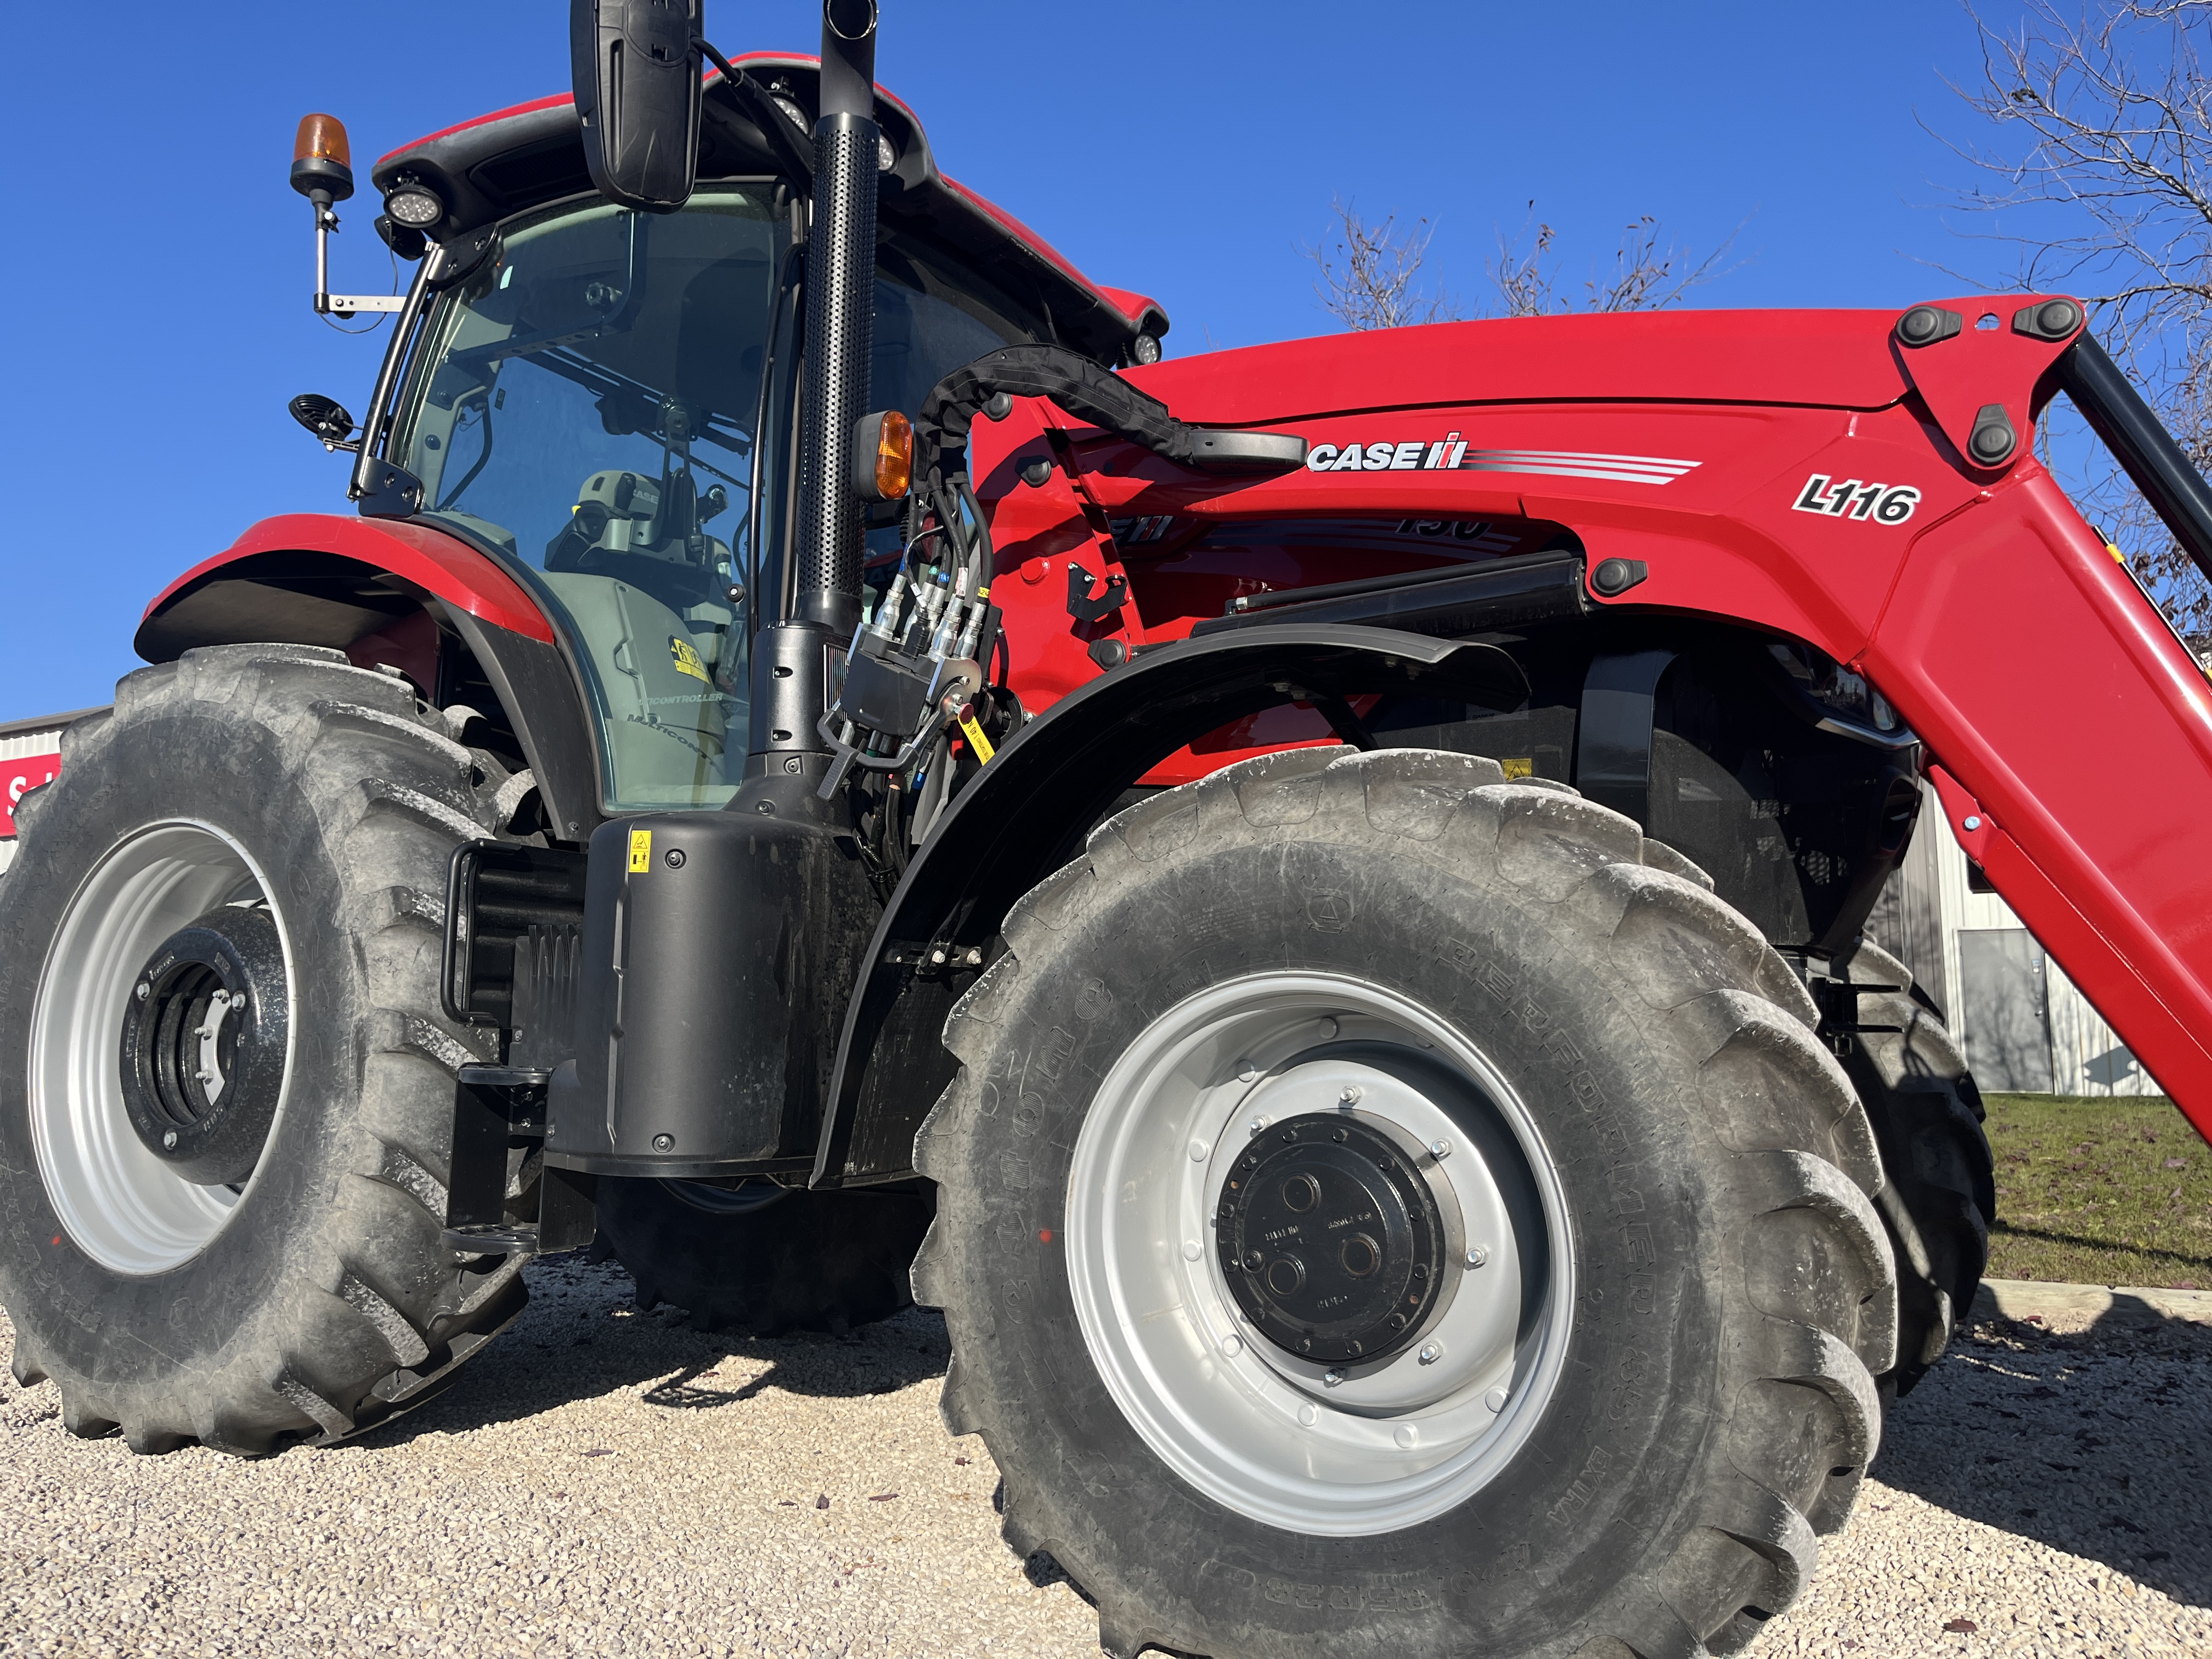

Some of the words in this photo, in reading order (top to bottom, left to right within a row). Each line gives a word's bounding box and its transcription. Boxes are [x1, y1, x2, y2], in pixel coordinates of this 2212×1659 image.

[1306, 441, 1426, 472] CASE
[1792, 473, 1921, 525] L116
[1547, 1444, 1613, 1528] EXTRA
